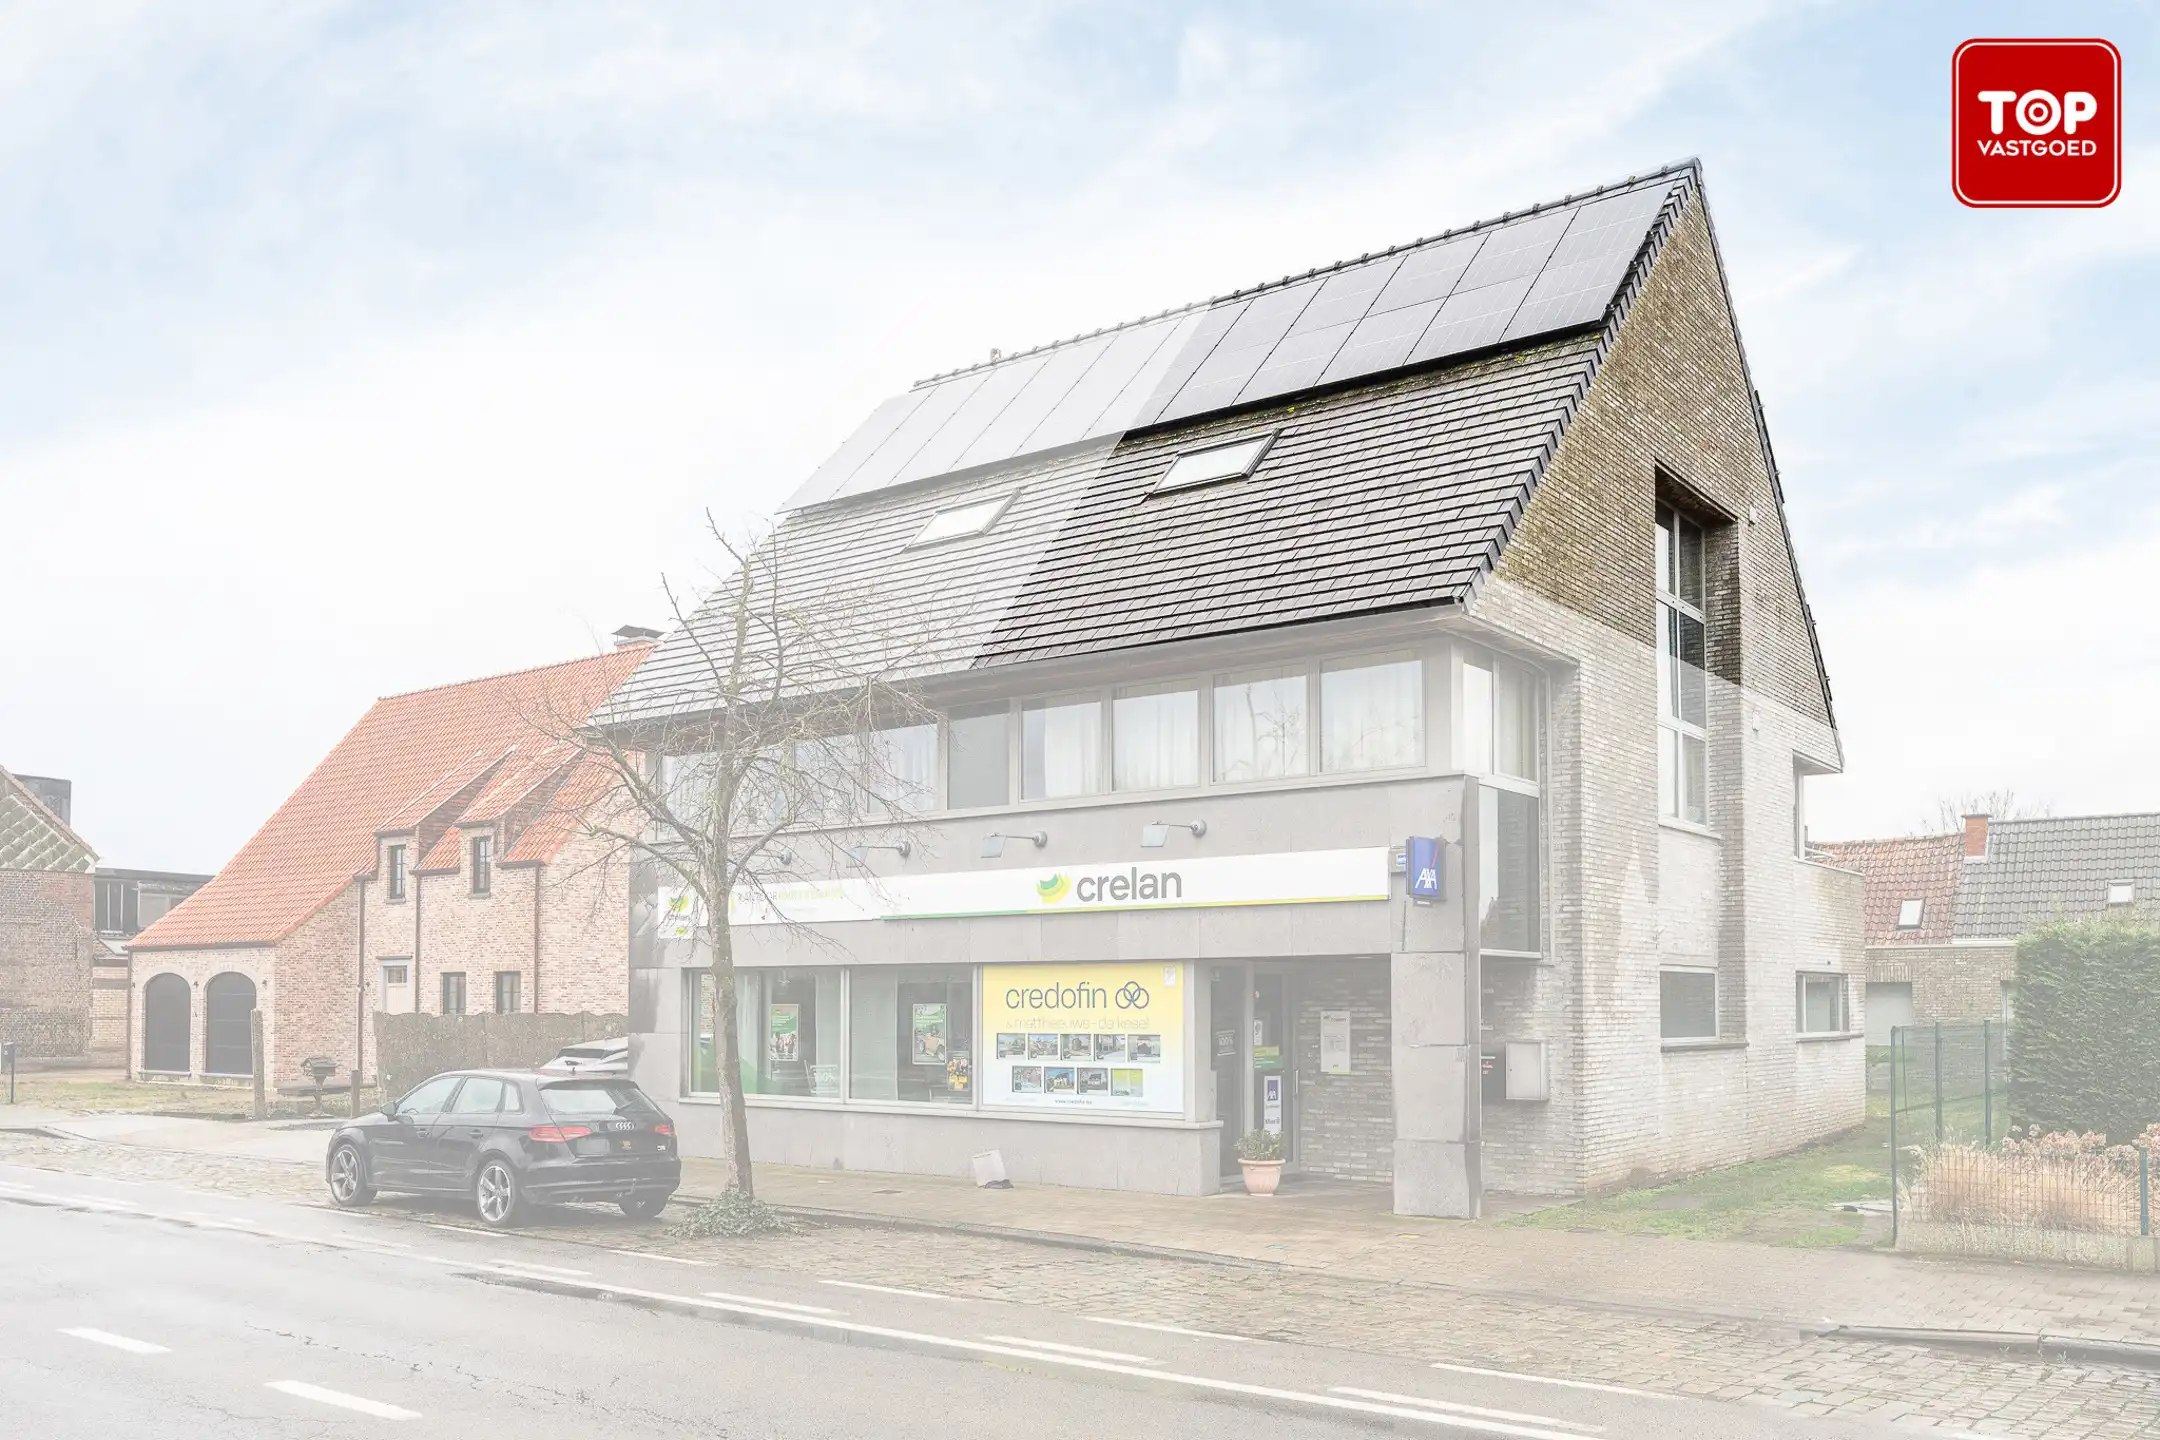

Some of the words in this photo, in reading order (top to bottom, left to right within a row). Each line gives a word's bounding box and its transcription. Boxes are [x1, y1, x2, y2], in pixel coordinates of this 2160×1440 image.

[1076, 866, 1182, 902] crelan
[1415, 867, 1438, 890] AXA
[1006, 982, 1107, 1009] credofin
